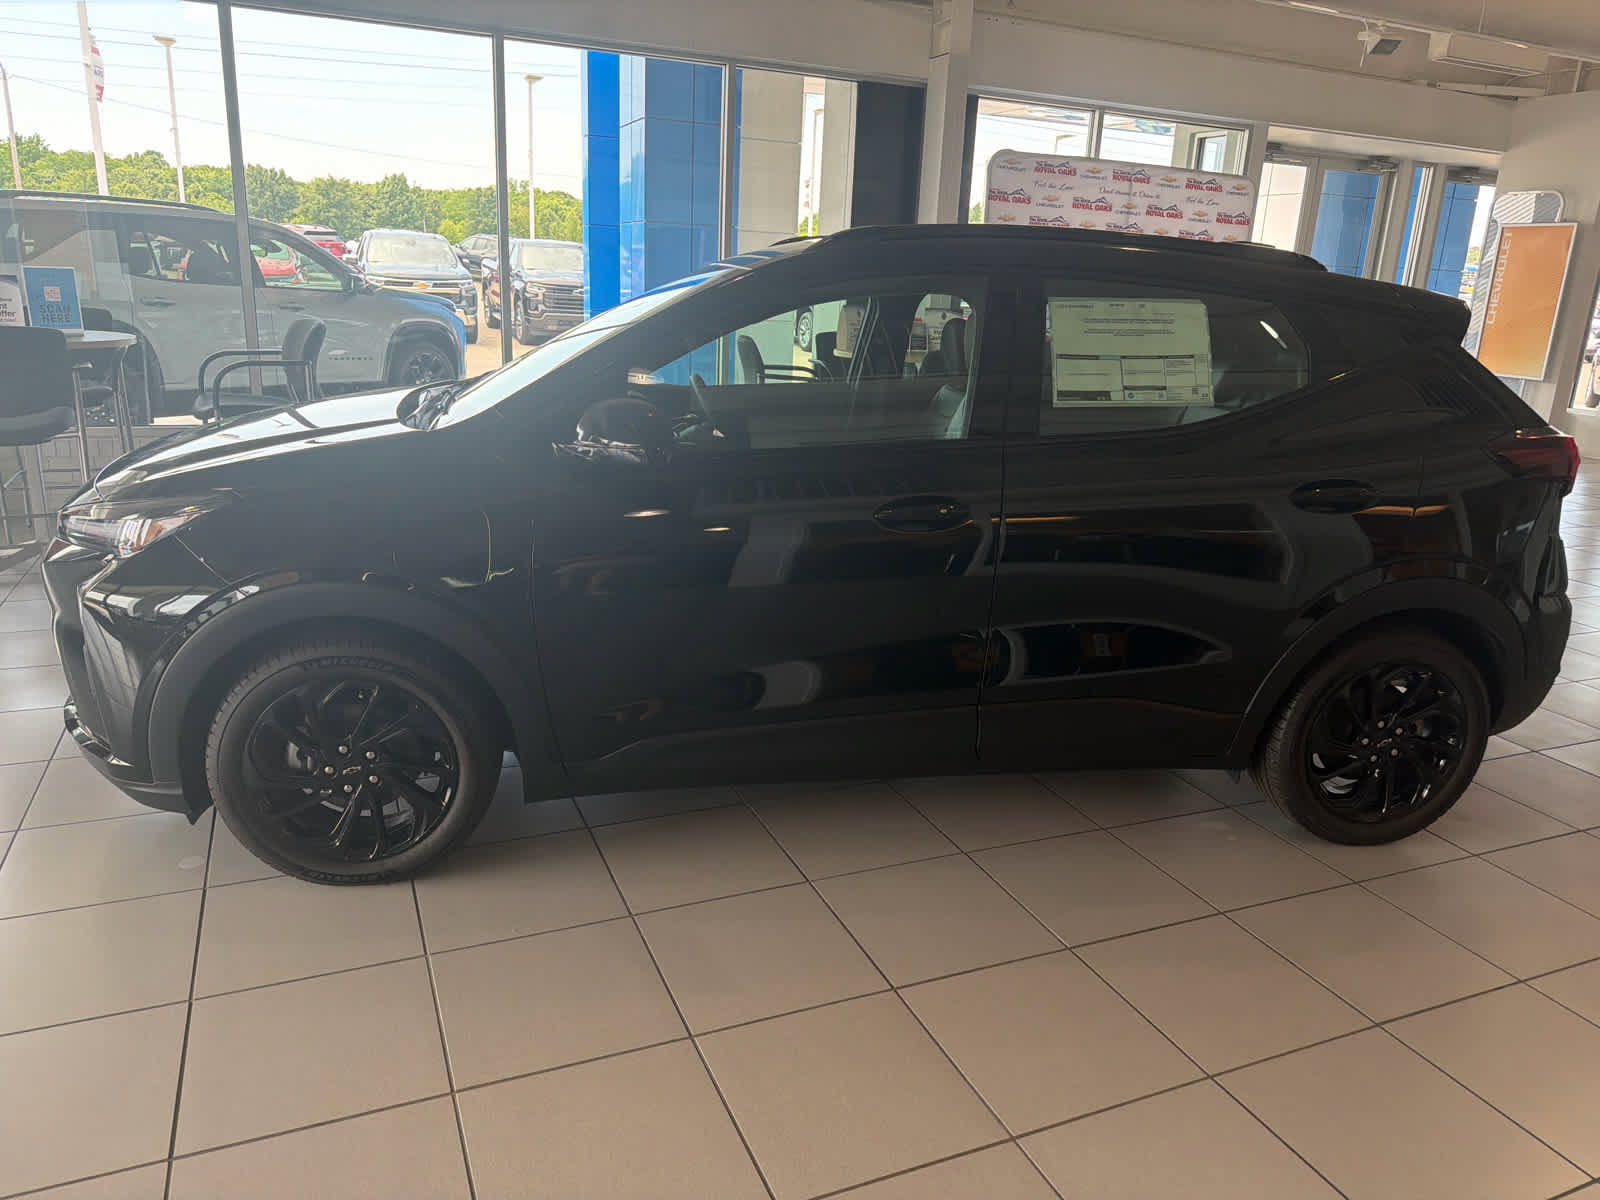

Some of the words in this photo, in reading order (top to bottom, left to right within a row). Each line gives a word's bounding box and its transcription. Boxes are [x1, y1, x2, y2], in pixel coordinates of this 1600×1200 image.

[1034, 166, 1056, 174] ROYAL
[1058, 168, 1077, 176] OAKS
[1112, 174, 1131, 182] ROYAL
[1185, 183, 1205, 191] ROYAL
[1206, 185, 1223, 193] OAKS
[988, 194, 1010, 203] ROYAL
[1012, 195, 1032, 204] OAKS
[1072, 202, 1093, 210] ROYAL
[1094, 204, 1112, 212] OAKS
[1145, 209, 1165, 218] ROYAL
[1166, 211, 1184, 219] OAKS
[1216, 217, 1233, 225] ROYAL
[1234, 218, 1250, 226] OAKS
[1487, 231, 1513, 324] CHEVROLET
[40, 304, 72, 313] SCAN
[41, 312, 72, 322] HERE
